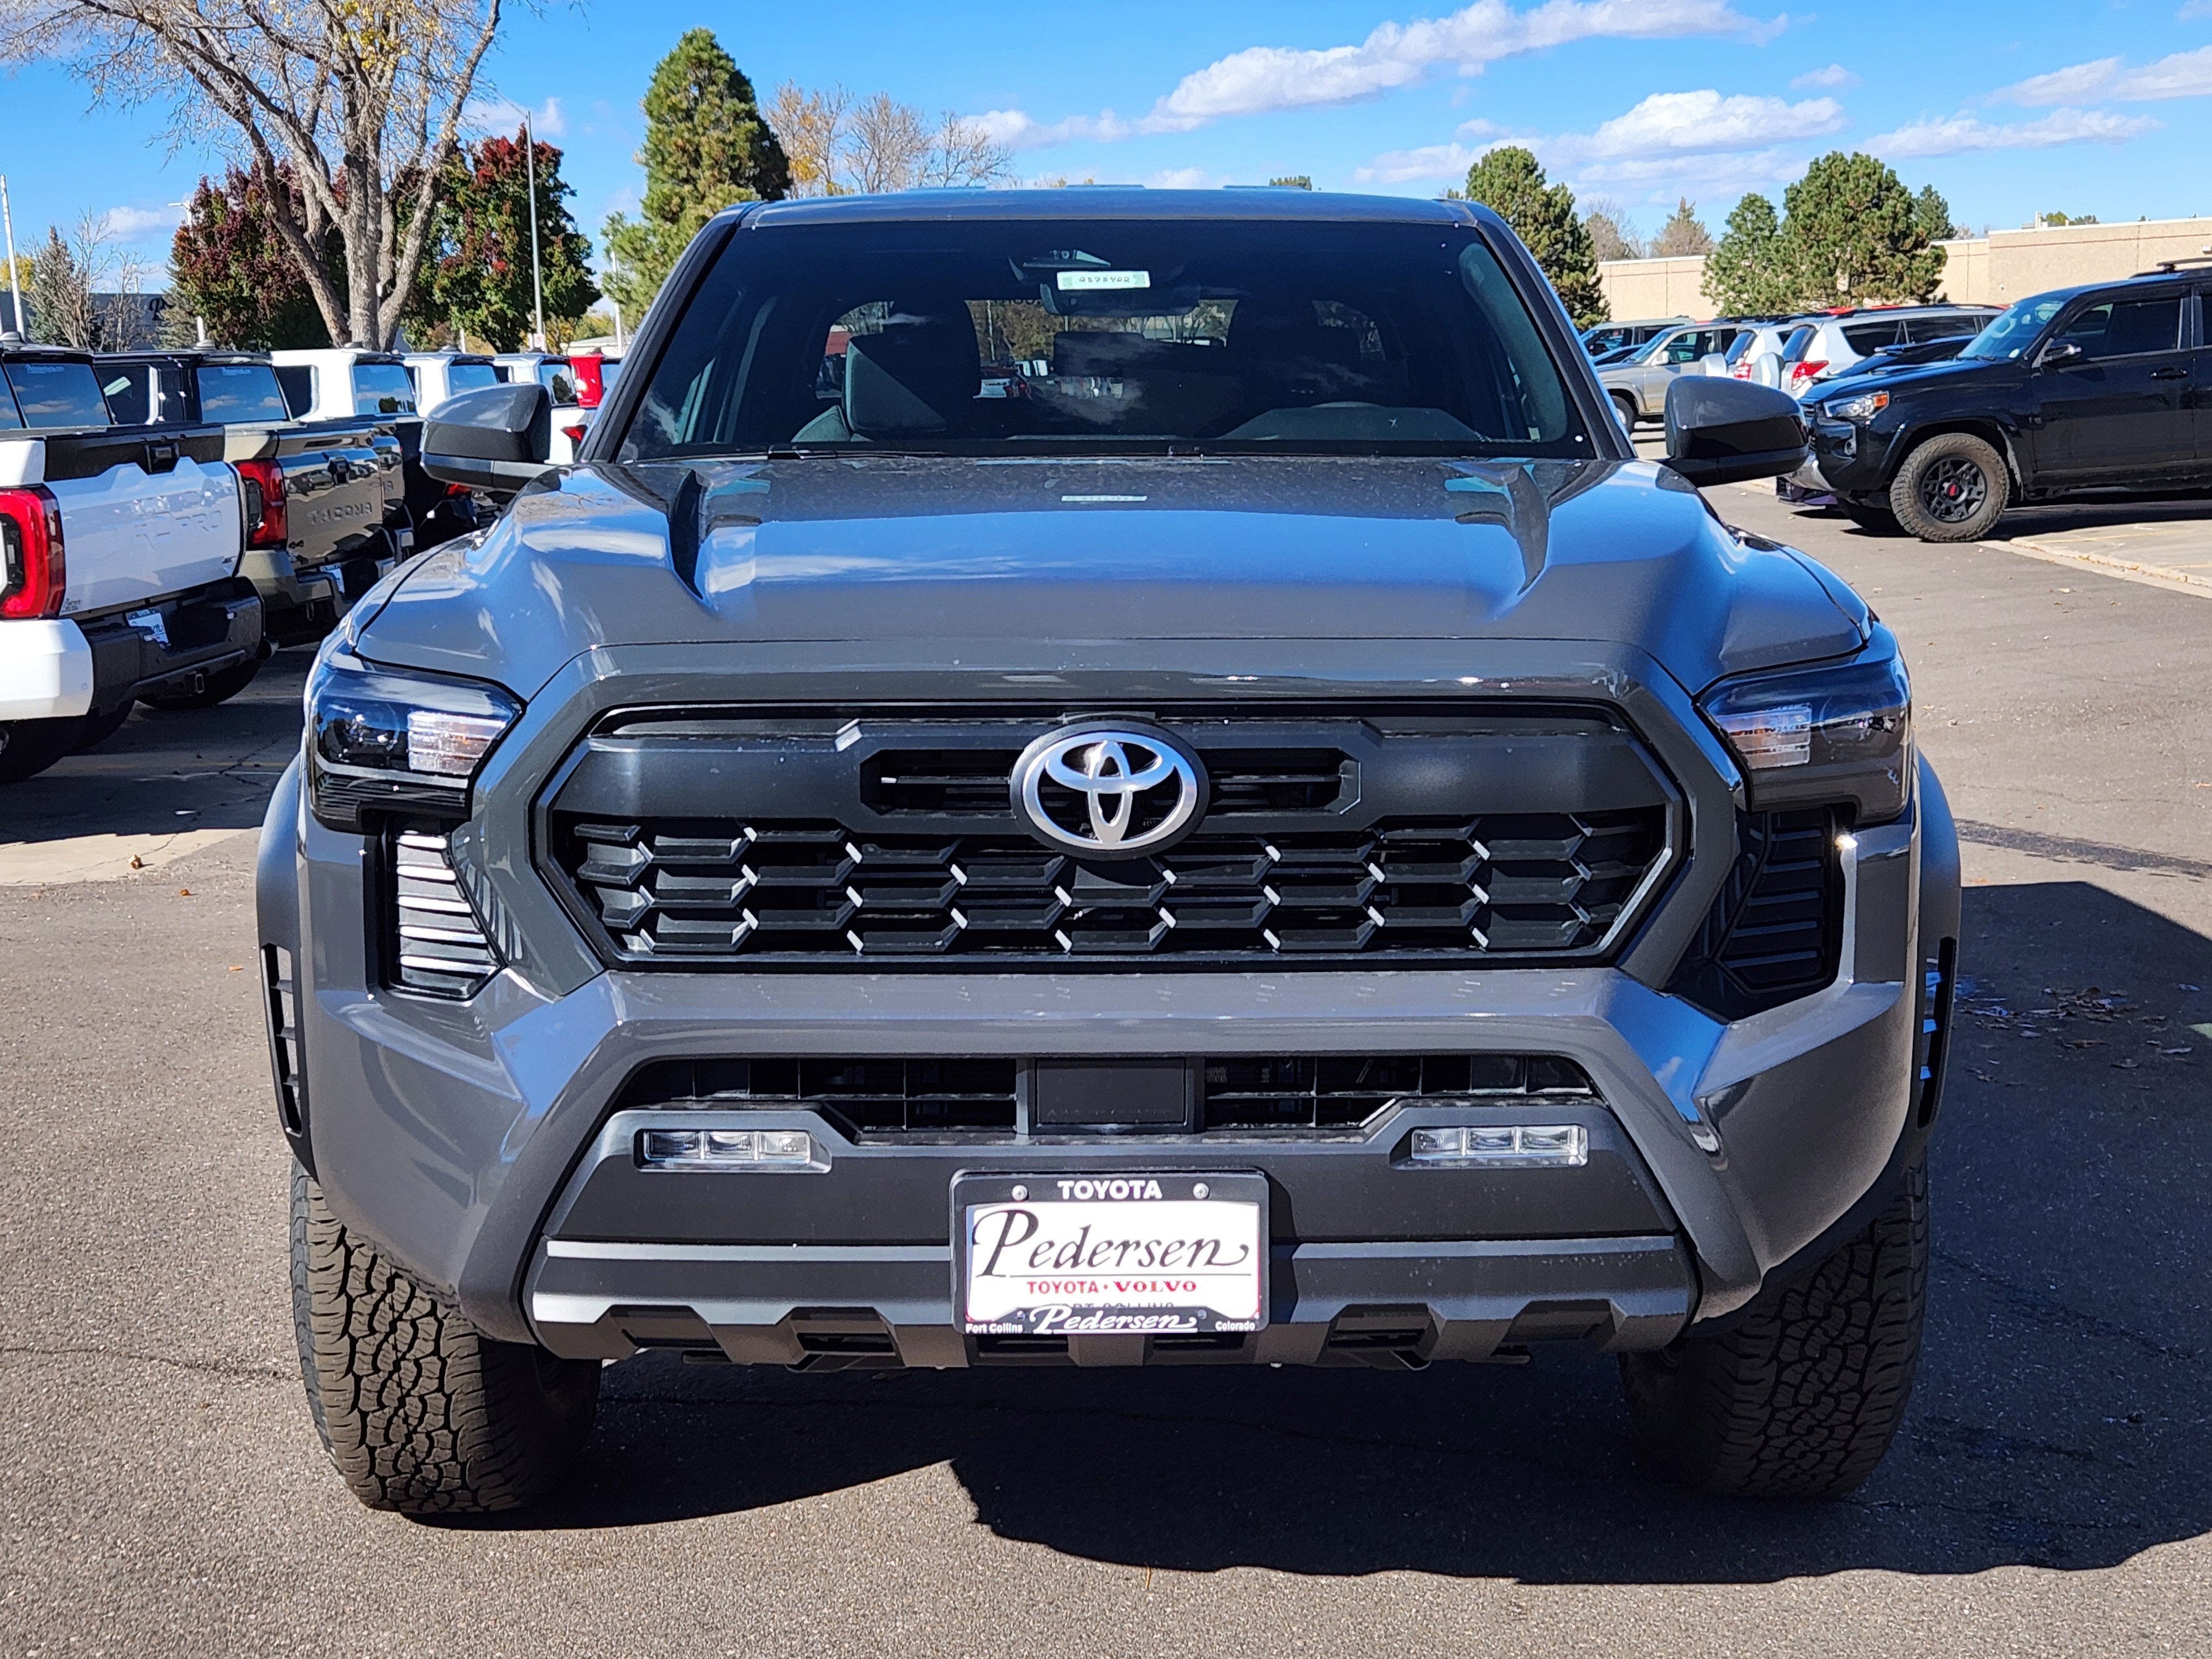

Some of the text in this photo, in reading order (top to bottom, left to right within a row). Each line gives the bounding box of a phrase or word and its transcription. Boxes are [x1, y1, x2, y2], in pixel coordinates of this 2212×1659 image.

[1057, 1180, 1162, 1199] TOYOTA
[972, 1209, 1250, 1279] Pedersen
[1026, 1280, 1197, 1295] TOYOTA VOLVO
[1029, 1303, 1197, 1334] Pedersen
[1215, 1320, 1255, 1332] Colorado
